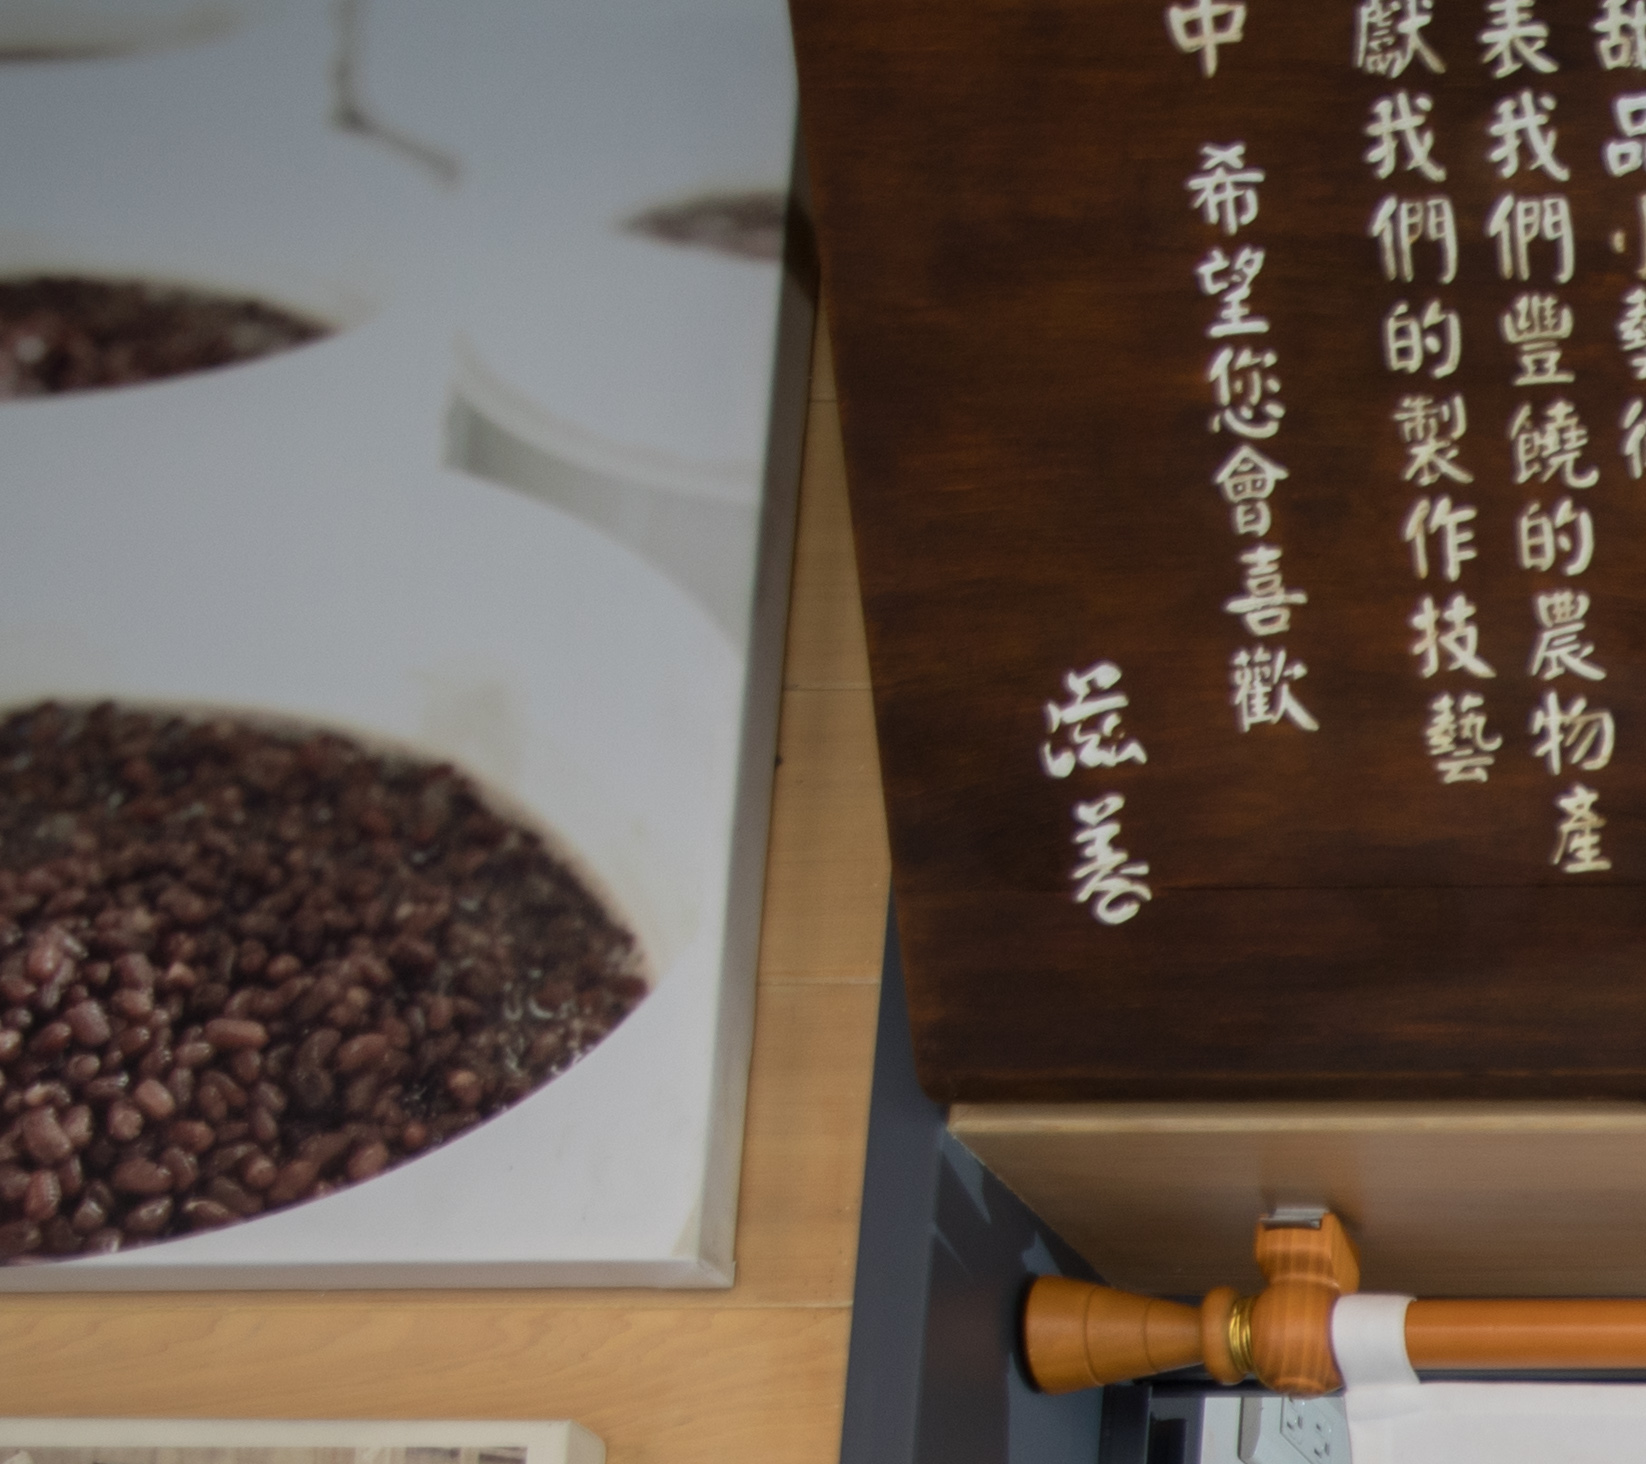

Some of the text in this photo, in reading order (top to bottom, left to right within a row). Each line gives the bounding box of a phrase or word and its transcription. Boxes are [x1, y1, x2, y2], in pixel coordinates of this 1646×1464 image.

[1188, 144, 1318, 732] 希望您會喜歡
